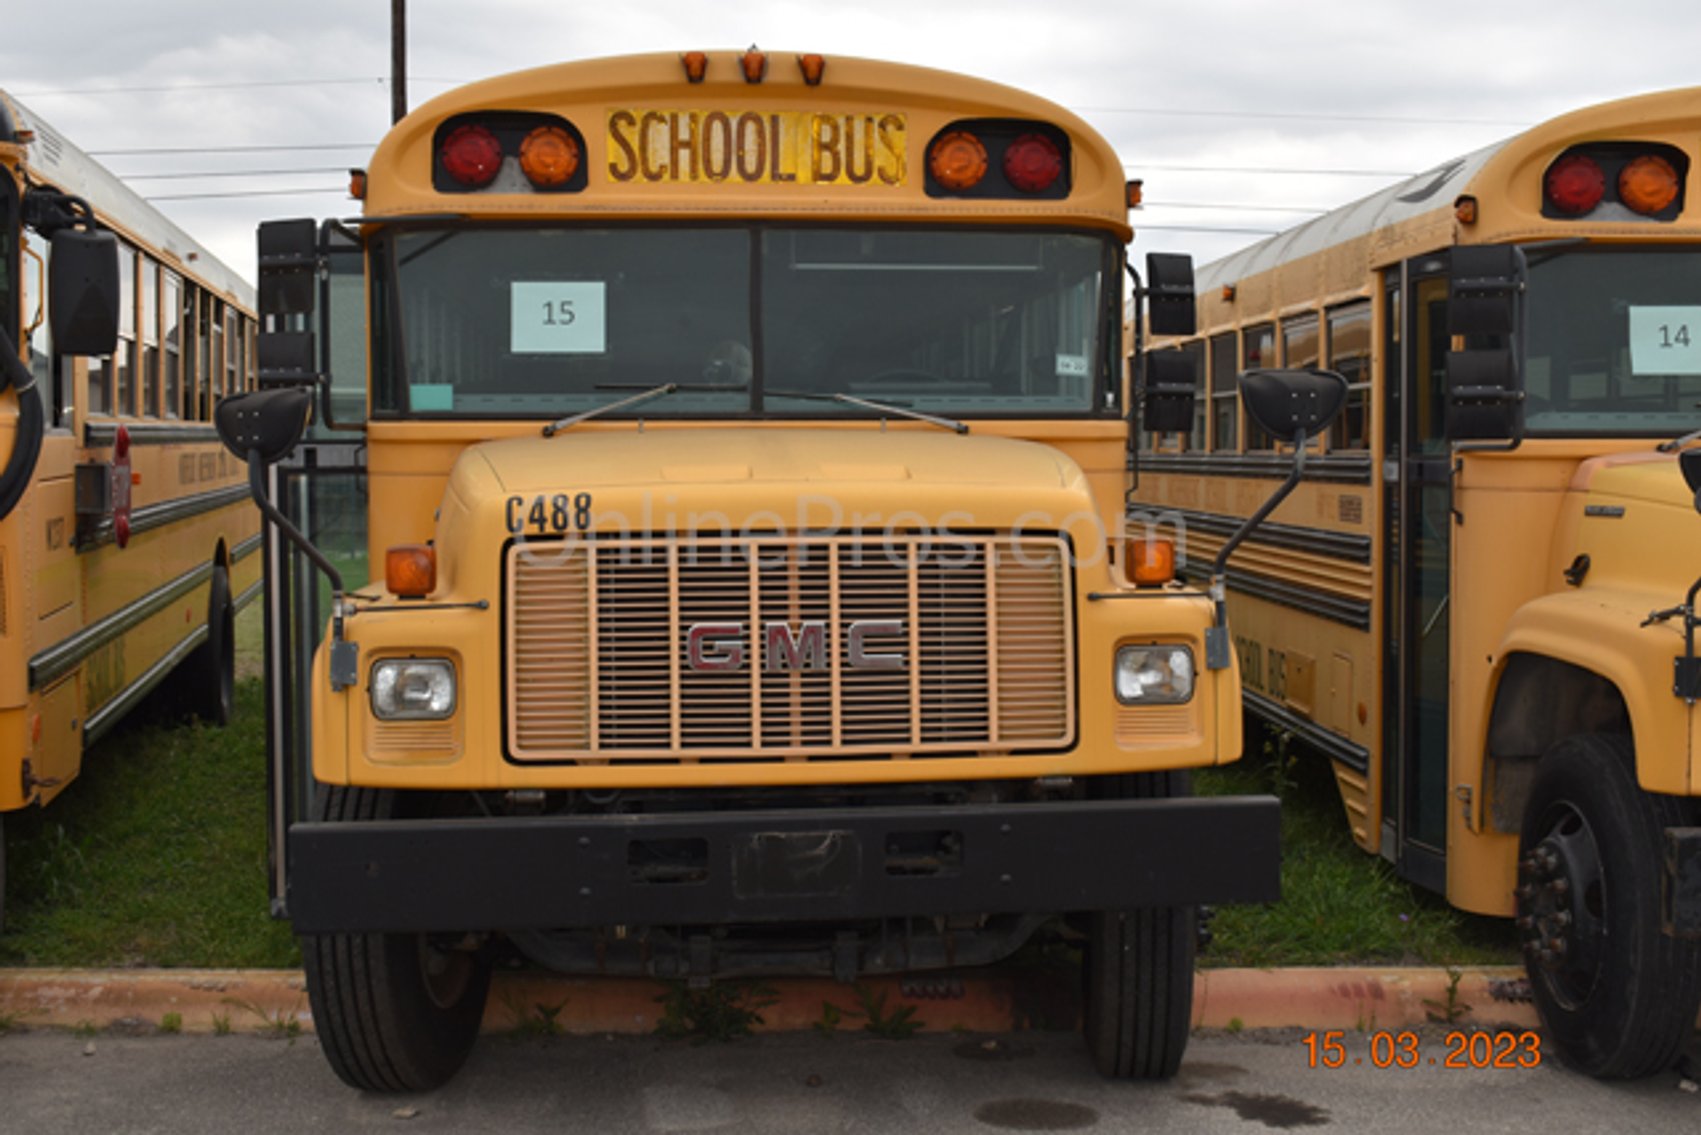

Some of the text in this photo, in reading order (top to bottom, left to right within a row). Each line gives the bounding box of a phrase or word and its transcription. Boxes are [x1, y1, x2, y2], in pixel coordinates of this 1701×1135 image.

[608, 111, 906, 184] SCHOOL BUS
[541, 301, 576, 325] 15
[1658, 324, 1691, 347] 14
[505, 492, 592, 533] C488
[687, 620, 903, 671] GMC
